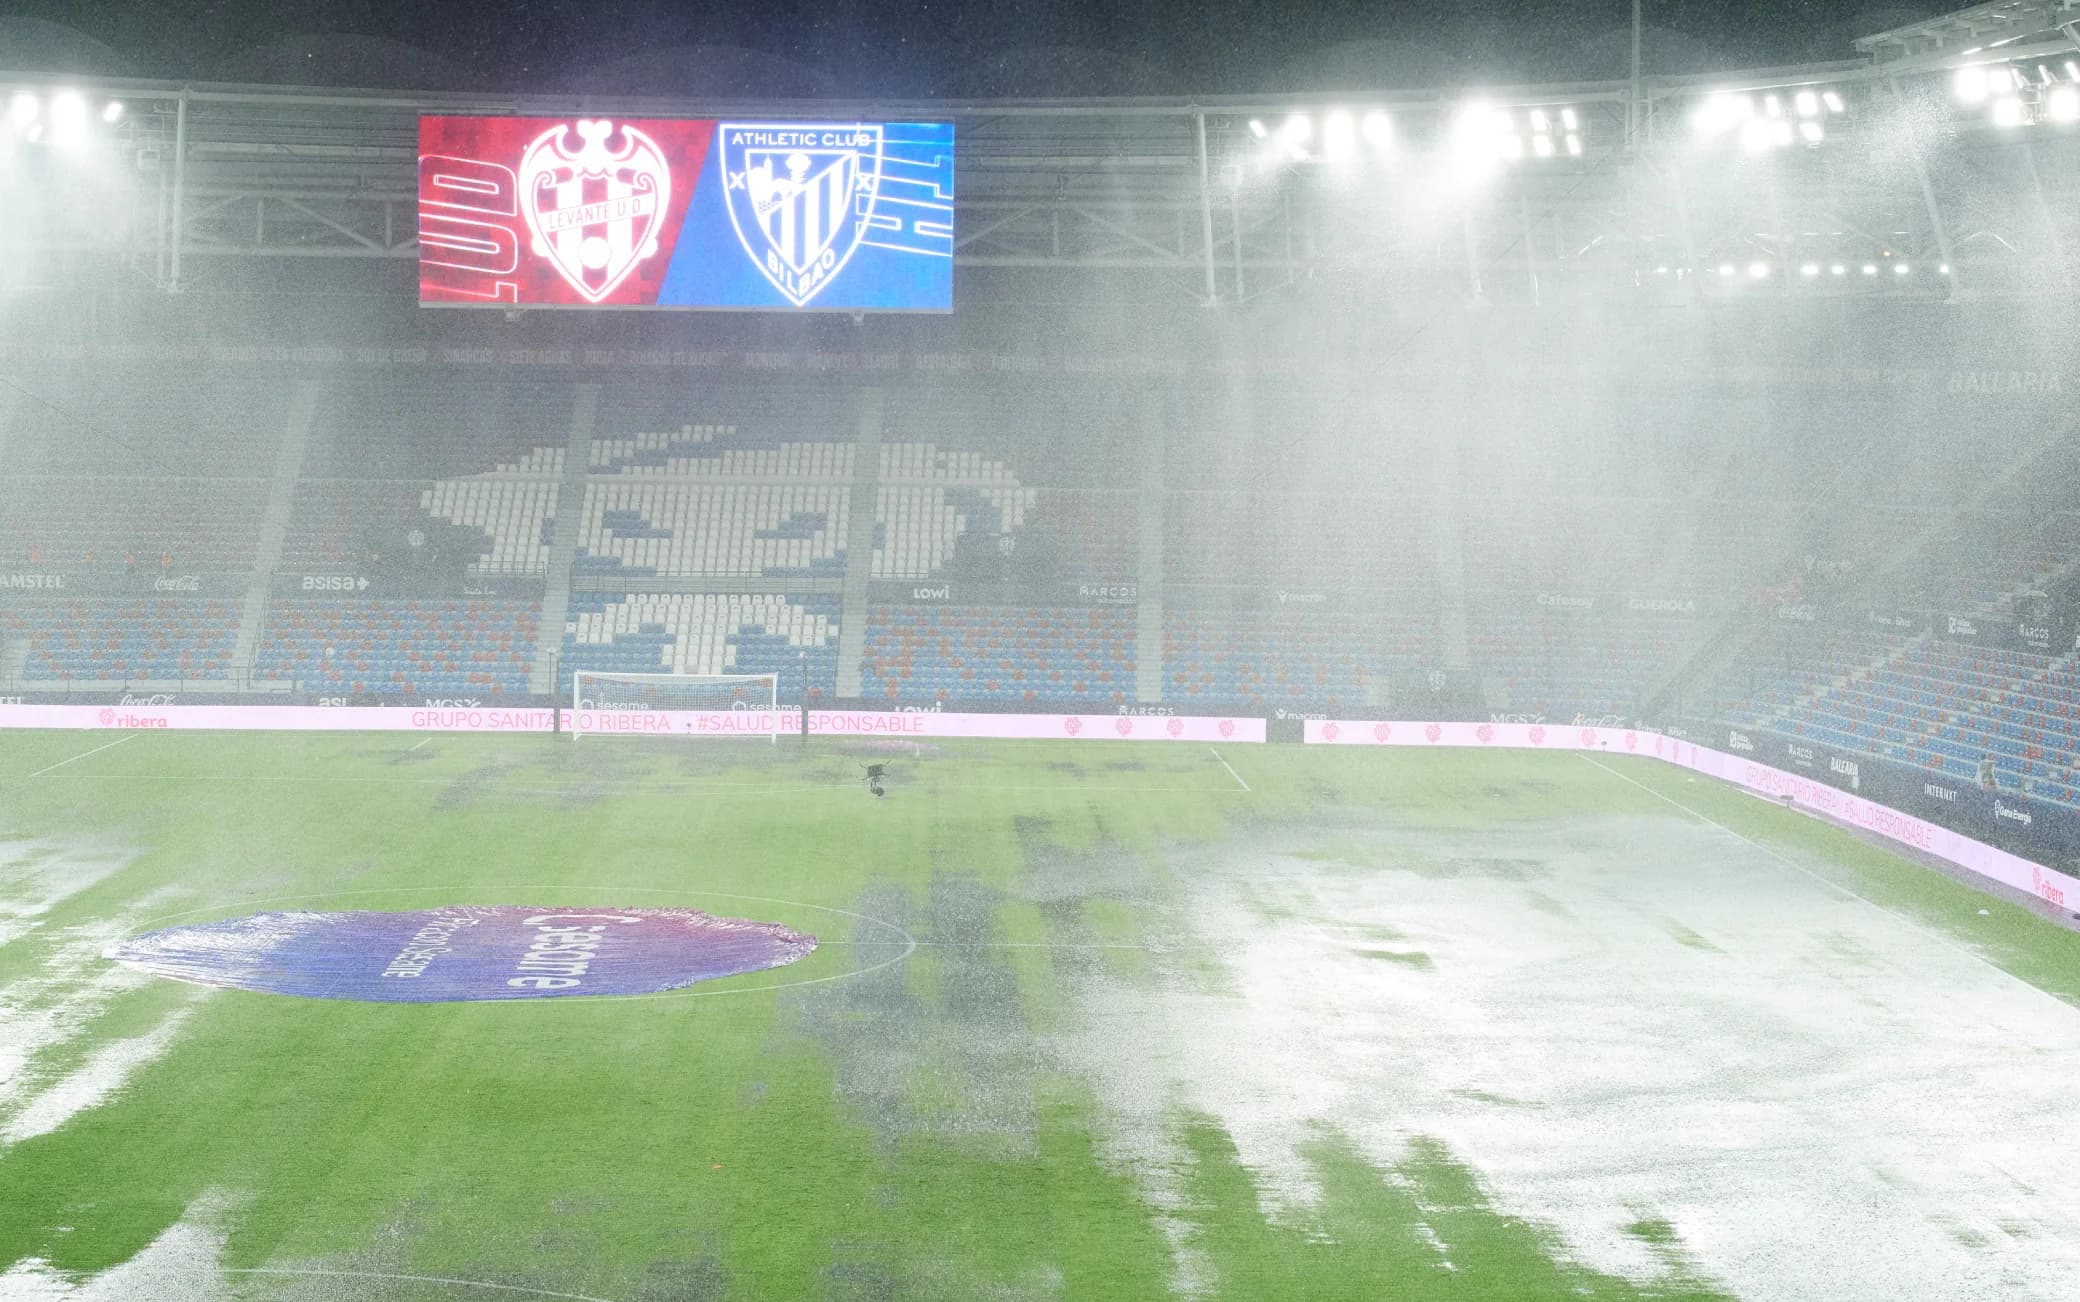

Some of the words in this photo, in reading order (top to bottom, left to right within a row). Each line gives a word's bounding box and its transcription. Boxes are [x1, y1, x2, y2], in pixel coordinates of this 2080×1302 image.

[732, 132, 817, 146] ATHLETIC
[822, 133, 871, 147] CLUB
[549, 202, 612, 229] LEVANTE
[768, 248, 836, 297] BILBAO
[0, 575, 64, 588] AMSTEL
[302, 576, 355, 590] asisa
[1079, 584, 1137, 597] MARCOS
[1629, 599, 1696, 612] GUEROLA
[1118, 704, 1174, 716] MARCOS
[117, 714, 168, 728] ribera
[411, 711, 482, 728] GRUPO
[599, 714, 671, 731] RIBERA
[696, 714, 775, 732] #SALUD
[781, 714, 926, 733] RESPONSABLE
[1924, 783, 1958, 802] INTERNXT
[2041, 879, 2065, 905] ribera
